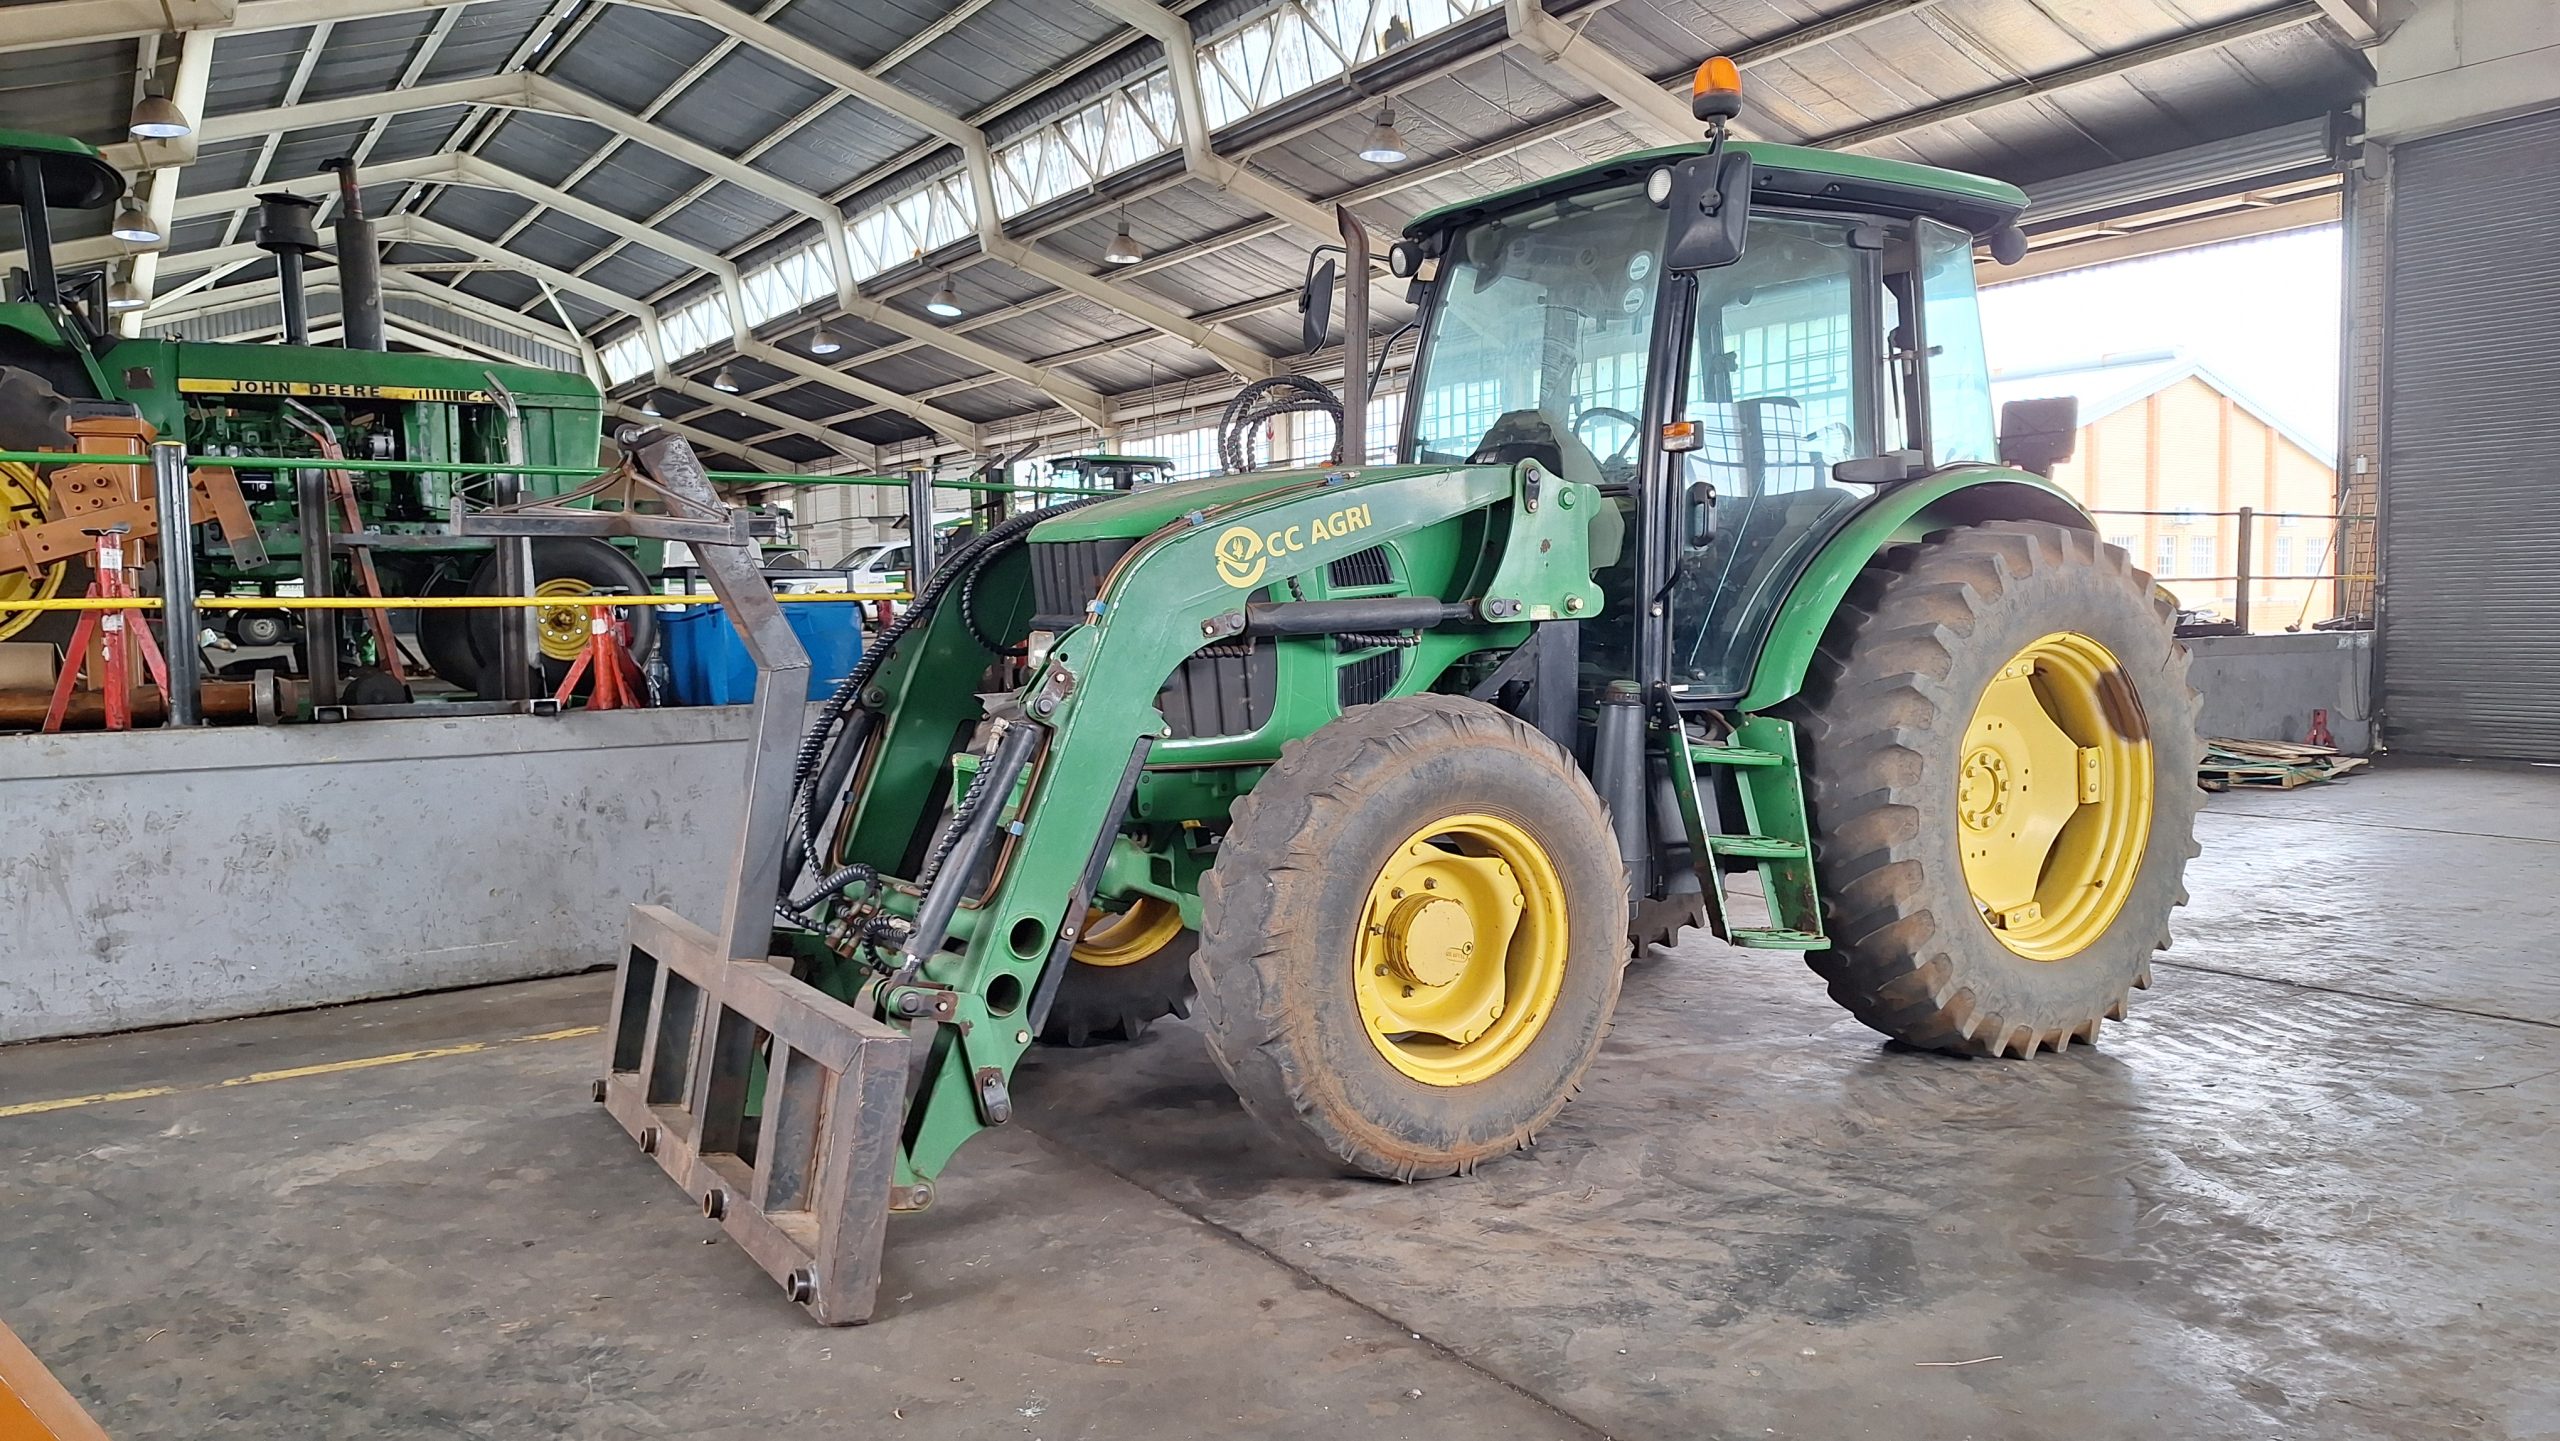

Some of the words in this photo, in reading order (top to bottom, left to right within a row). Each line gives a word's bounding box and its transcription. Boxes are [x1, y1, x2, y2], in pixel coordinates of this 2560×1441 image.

[231, 380, 291, 395] JOHN
[309, 383, 380, 398] DEERE
[1266, 525, 1304, 557] CC
[1311, 503, 1372, 545] AGRI
